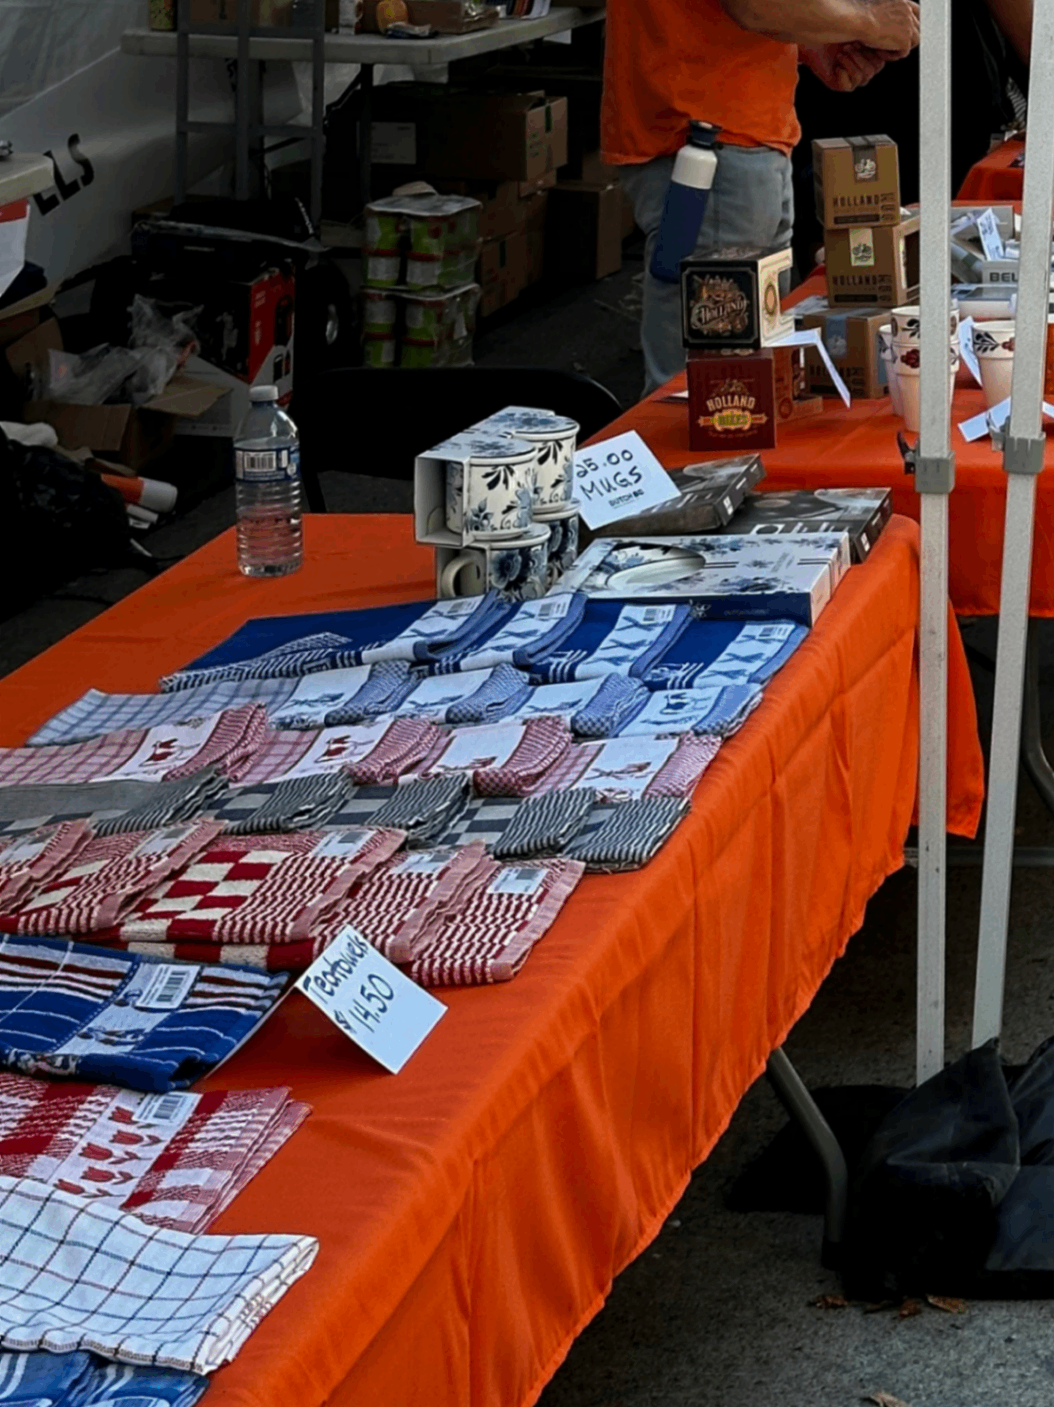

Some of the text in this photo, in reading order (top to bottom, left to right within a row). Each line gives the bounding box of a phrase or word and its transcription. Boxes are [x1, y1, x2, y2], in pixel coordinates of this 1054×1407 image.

[833, 194, 880, 207] HOLLAND
[832, 275, 877, 286] HOLLAND
[706, 395, 756, 412] HOLLAND
[575, 449, 633, 478] 25.00
[580, 465, 642, 501] MUGS
